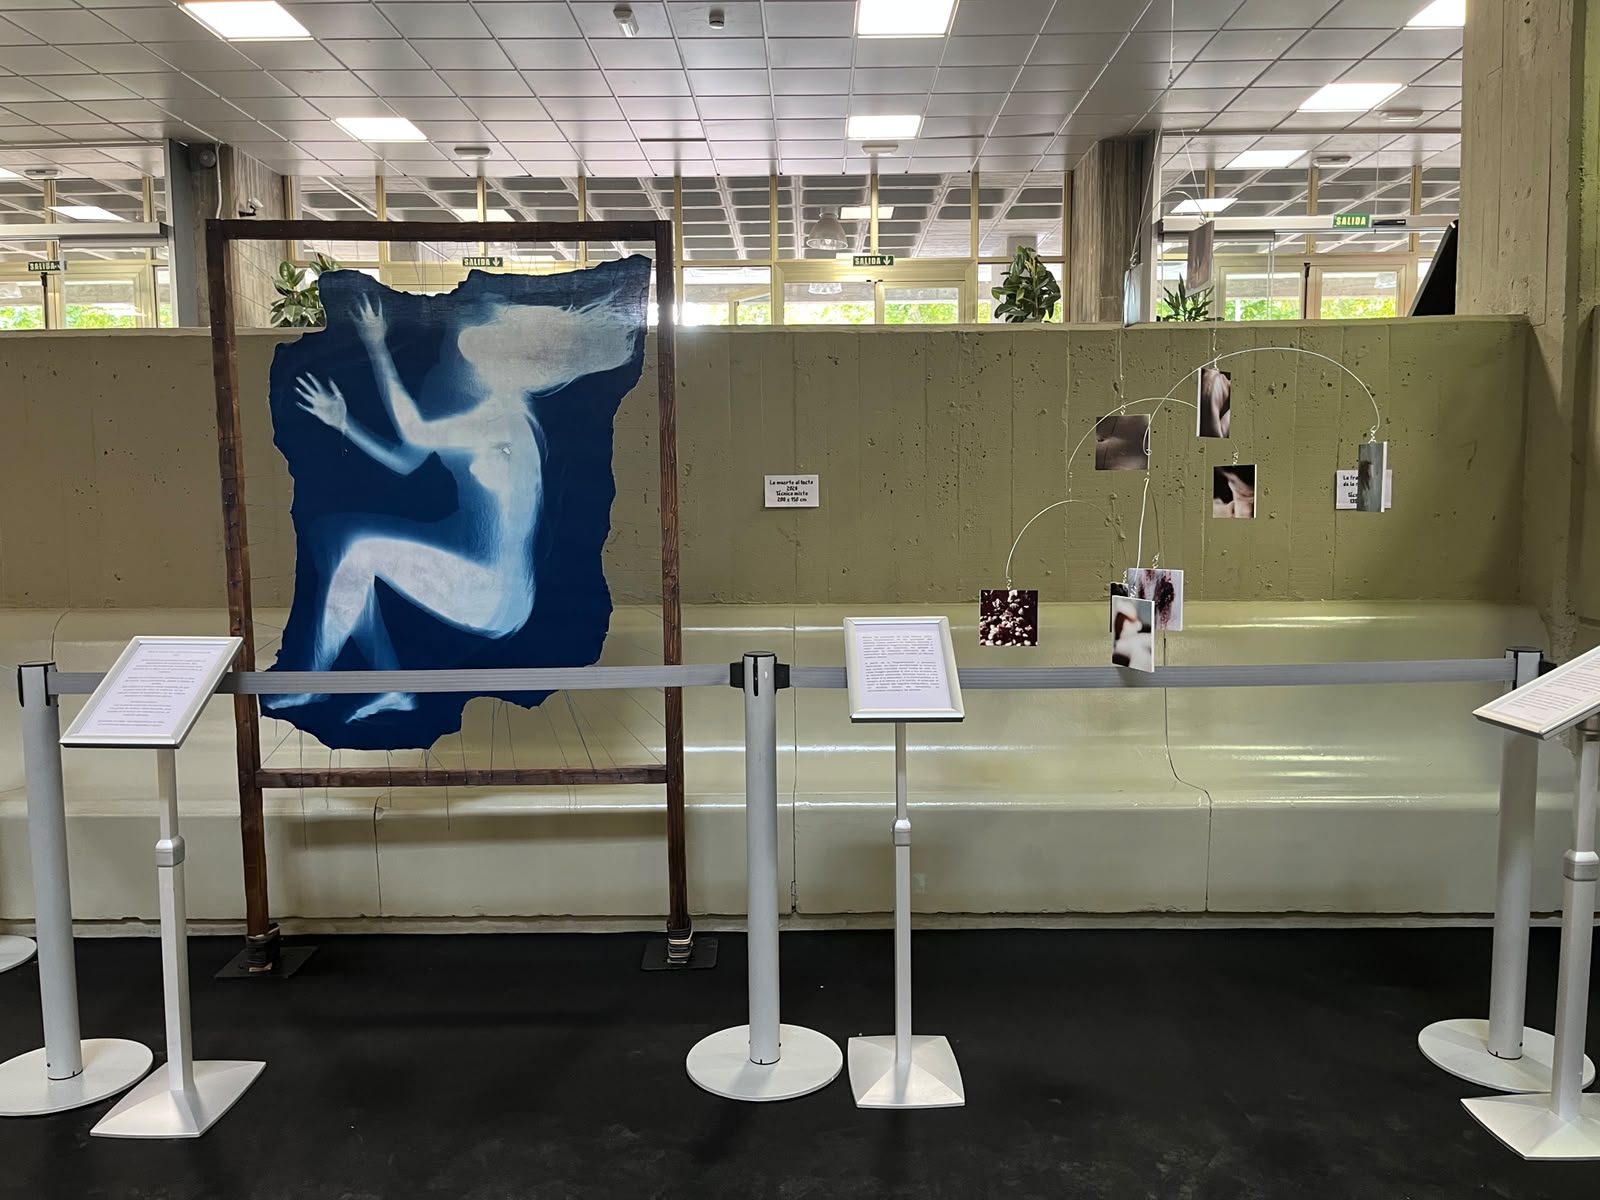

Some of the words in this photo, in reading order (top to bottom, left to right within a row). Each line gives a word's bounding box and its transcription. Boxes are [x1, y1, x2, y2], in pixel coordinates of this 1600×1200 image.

[1336, 216, 1366, 226] SALIDA
[464, 257, 490, 266] SALIDA
[855, 256, 881, 265] SALIDA
[29, 262, 55, 271] SALIDA
